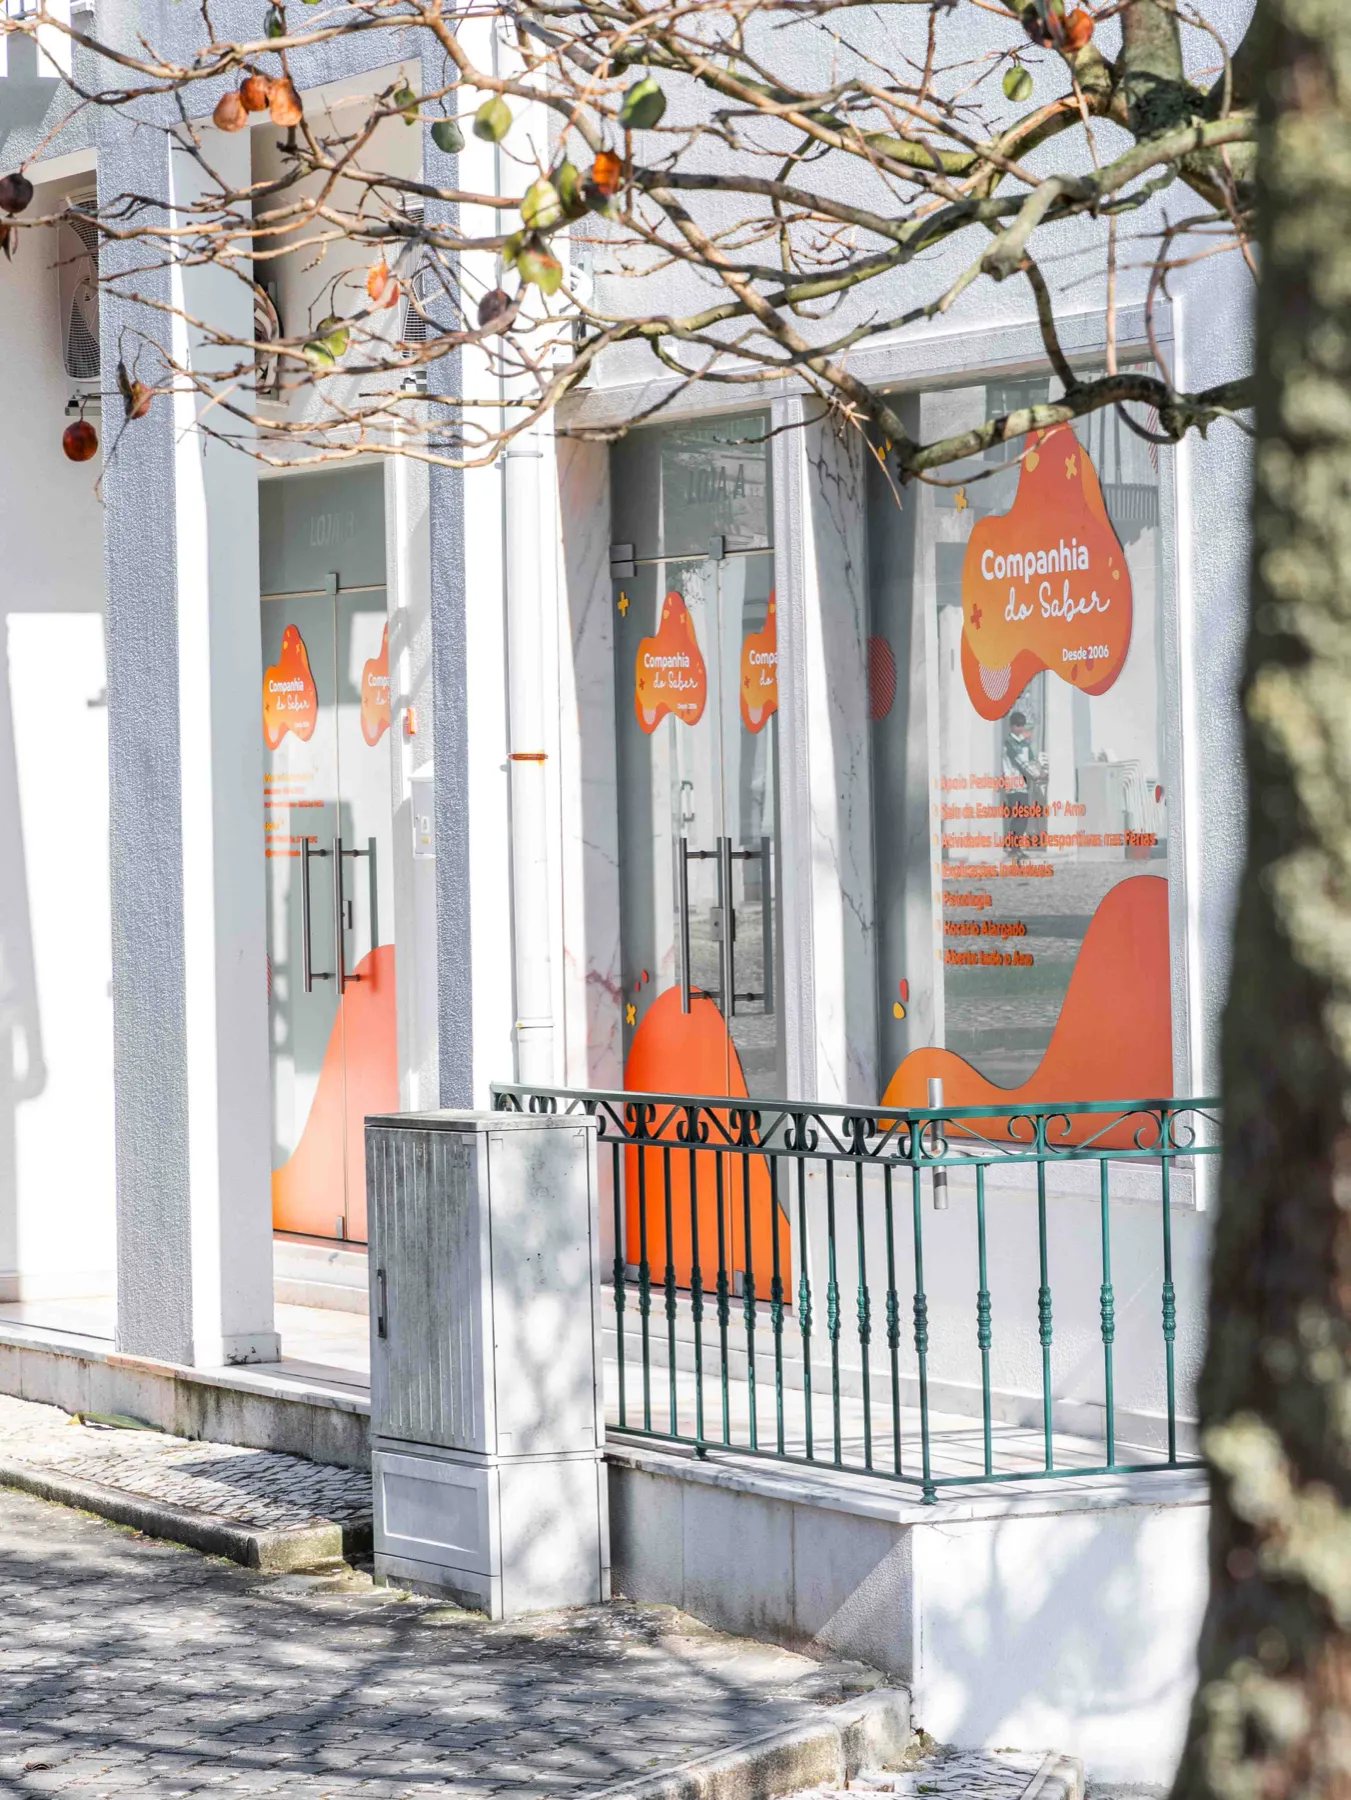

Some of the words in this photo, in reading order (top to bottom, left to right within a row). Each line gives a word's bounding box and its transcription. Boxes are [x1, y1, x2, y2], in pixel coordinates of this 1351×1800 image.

[980, 537, 1090, 584] Companhia
[1004, 586, 1034, 622] do
[1038, 578, 1111, 622] Saber
[643, 652, 690, 671] Companhia
[1062, 647, 1087, 662] Desde
[1087, 645, 1110, 660] 2006
[268, 677, 304, 695] Companhia
[653, 671, 666, 688] do
[667, 671, 699, 691] Saber
[286, 694, 310, 712] Saber
[1011, 800, 1041, 817] desde
[1042, 805, 1050, 817] o
[1063, 800, 1086, 817] Ano
[1031, 834, 1039, 847] e
[1123, 828, 1156, 847] Férias
[942, 889, 992, 911] Psicologia
[943, 919, 980, 936] Horário
[980, 919, 1027, 940] Alargado
[943, 948, 978, 965] Aberto
[1003, 953, 1012, 966] o
[1012, 948, 1034, 967] Ano
